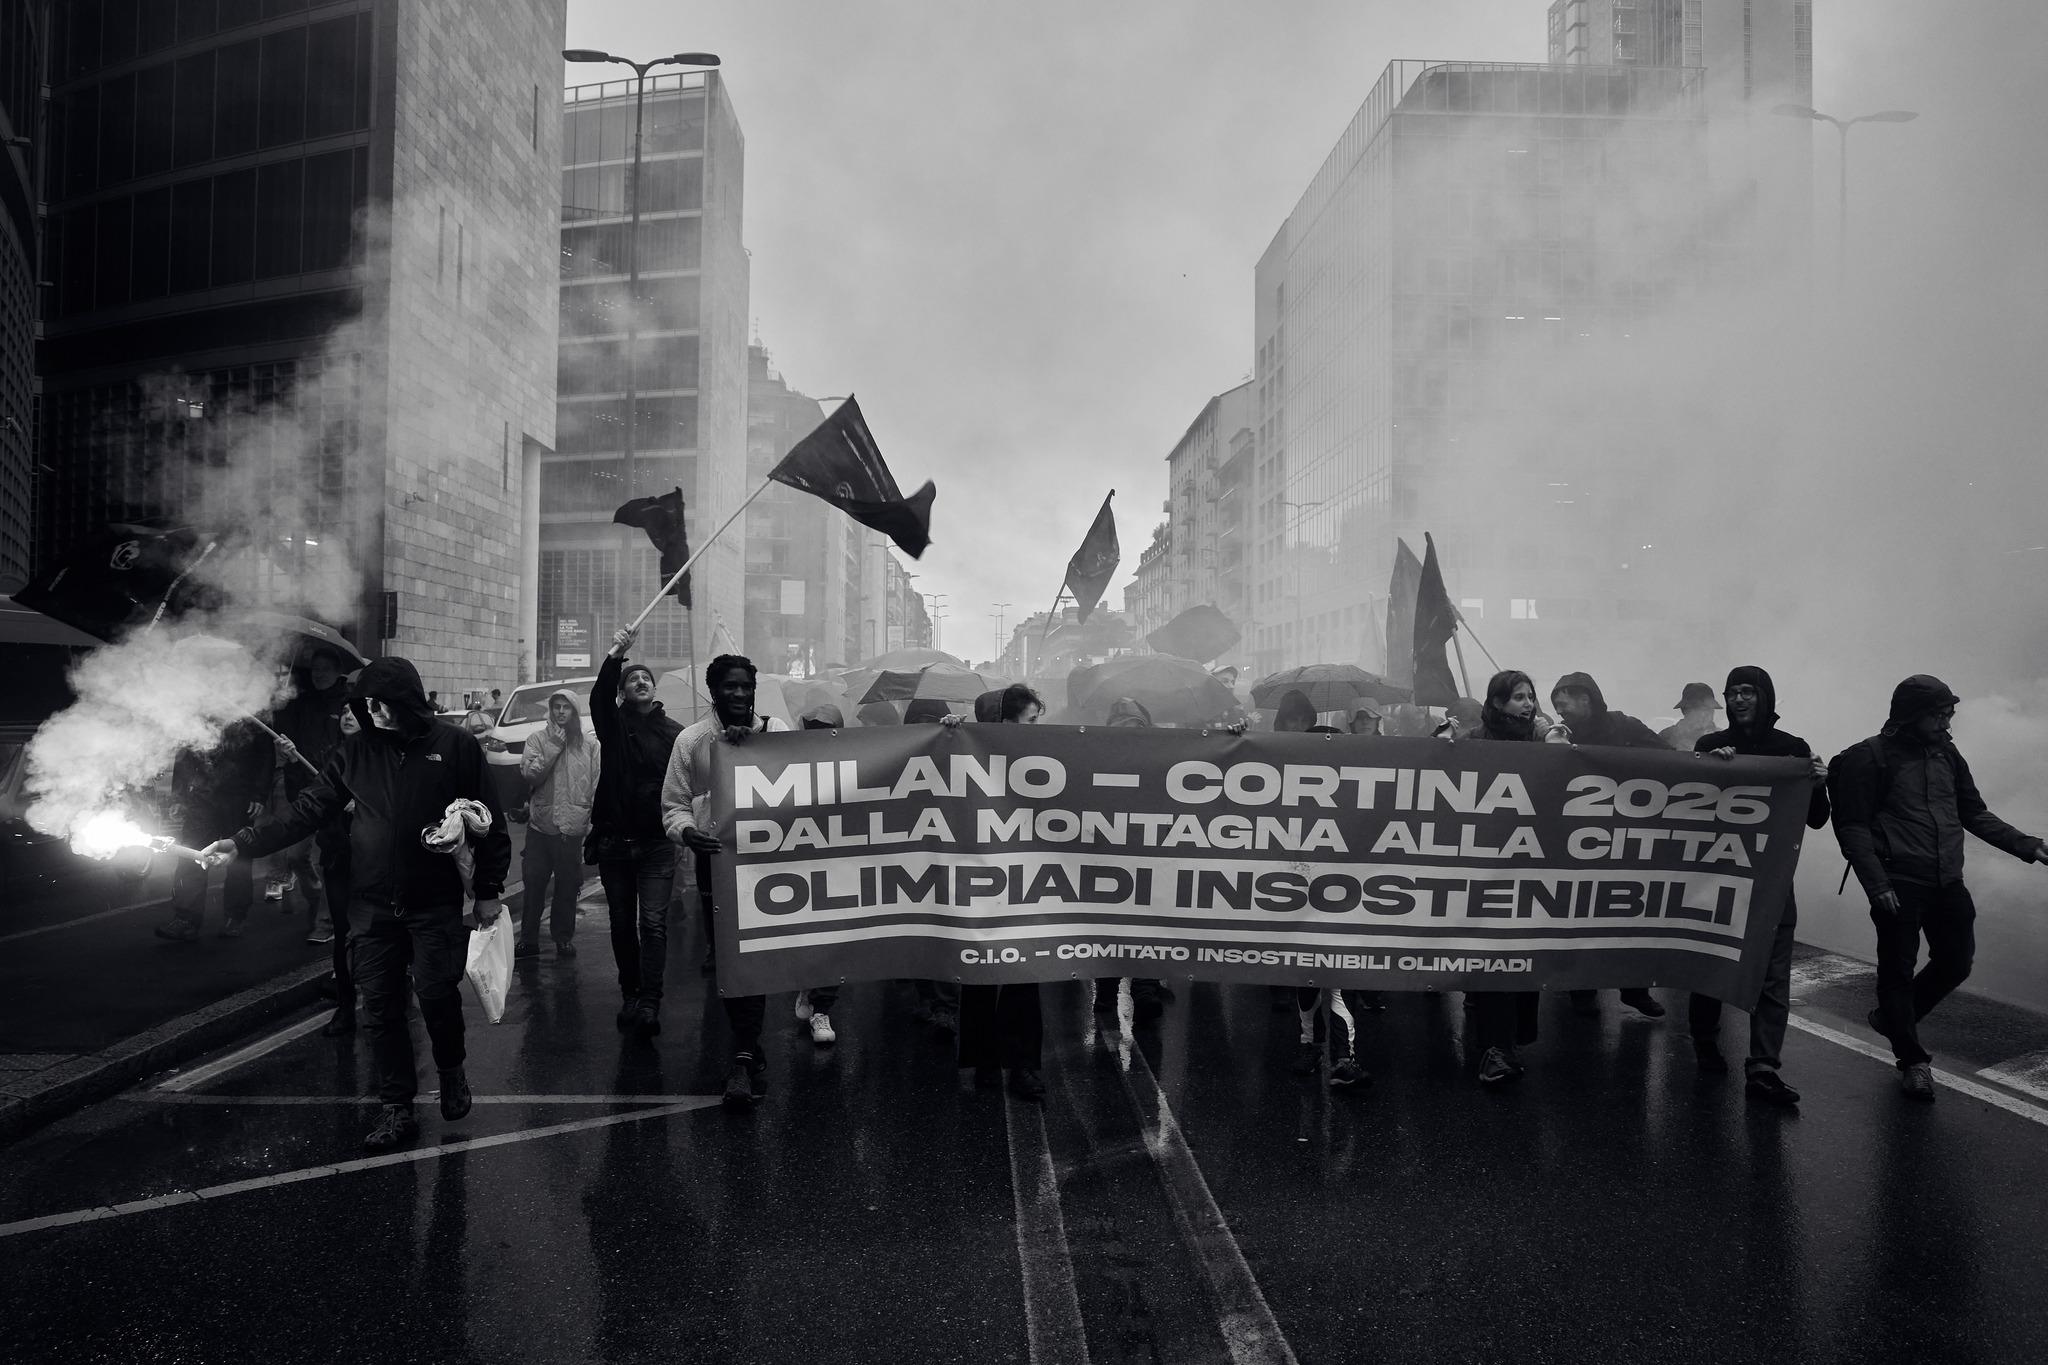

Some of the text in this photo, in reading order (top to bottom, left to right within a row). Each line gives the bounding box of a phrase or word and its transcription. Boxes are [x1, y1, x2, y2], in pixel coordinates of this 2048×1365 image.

[735, 754, 1066, 808] MILANO
[1166, 760, 1536, 815] CORTINA
[1562, 775, 1772, 824] 2026
[736, 807, 1768, 868] DALLA MONTAGNA ALLA CITTA'
[753, 864, 1737, 926] OLIMPIADI INSOSTENIBILI
[960, 948, 1026, 965] C.I.O.
[1056, 943, 1190, 962] COMITATO
[1197, 948, 1391, 970] INSOSTENIBILI
[1398, 955, 1533, 973] OLIMPIADI
